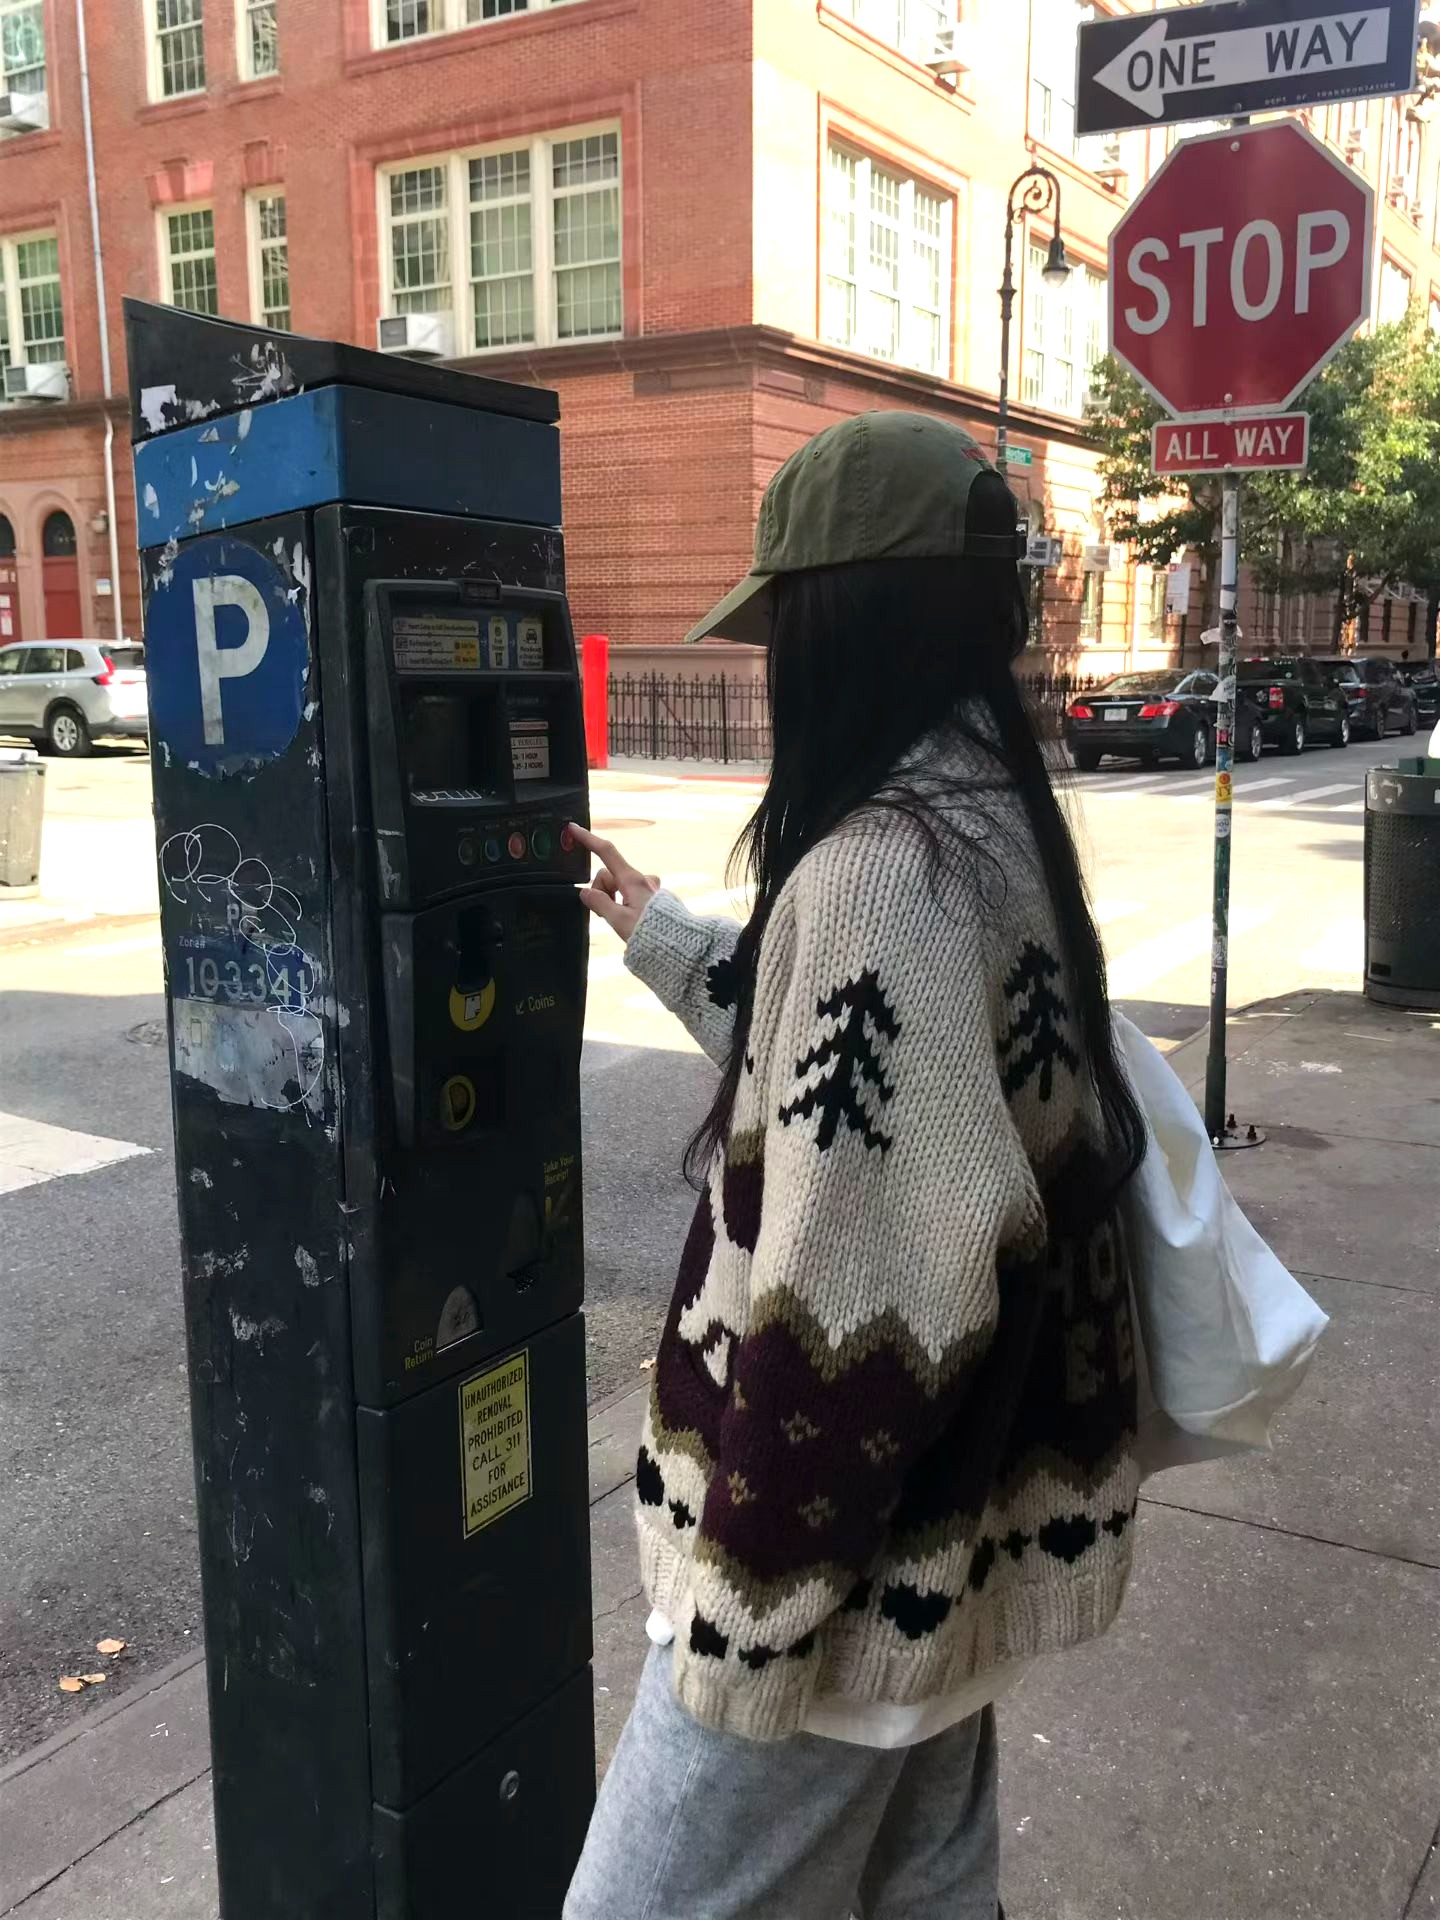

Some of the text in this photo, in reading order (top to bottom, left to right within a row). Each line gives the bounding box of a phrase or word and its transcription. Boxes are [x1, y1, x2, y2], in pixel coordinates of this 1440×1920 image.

[1127, 17, 1369, 93] ONE WAY
[1124, 210, 1351, 335] STOP
[1165, 425, 1294, 461] ALL WAY
[192, 574, 270, 745] P
[527, 994, 555, 1013] Coins
[404, 1348, 434, 1371] Return
[413, 1336, 433, 1353] Coin
[464, 1366, 523, 1410] UNAUTHORIZED
[477, 1395, 513, 1426] REMOVAL
[468, 1413, 523, 1452] PROHIBITED
[472, 1434, 521, 1471] CALL 311
[488, 1461, 506, 1484] FOR
[470, 1471, 526, 1517] ASSISTANCE
